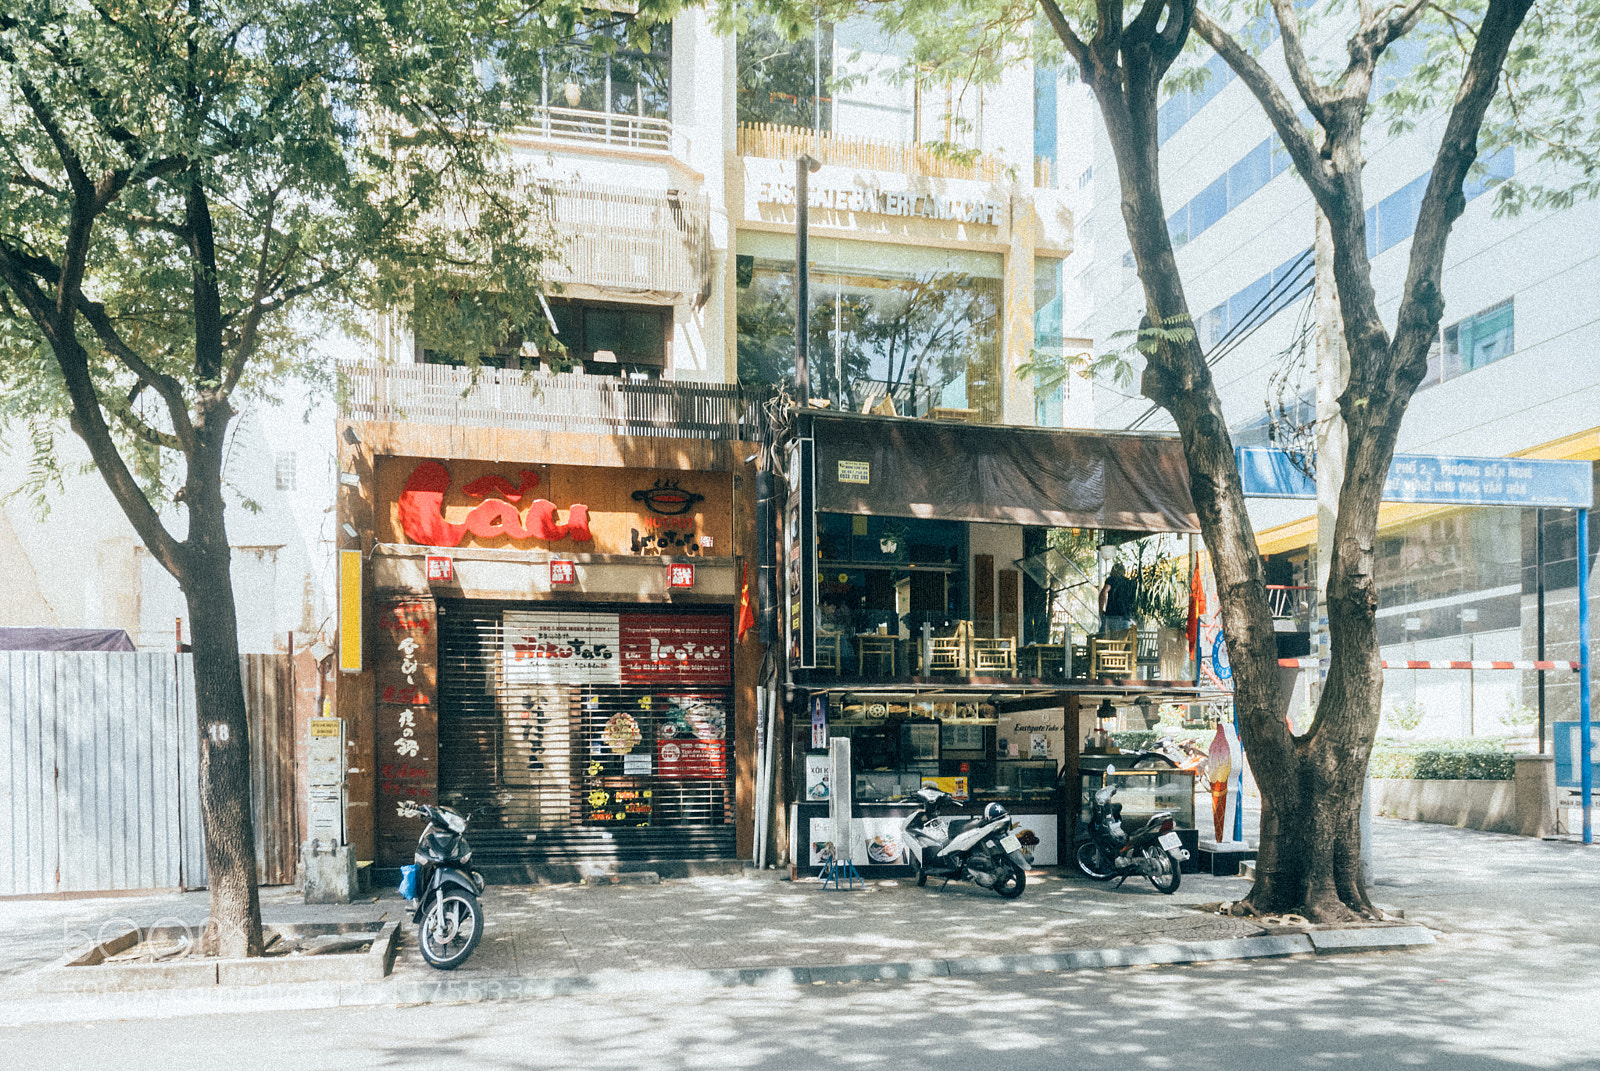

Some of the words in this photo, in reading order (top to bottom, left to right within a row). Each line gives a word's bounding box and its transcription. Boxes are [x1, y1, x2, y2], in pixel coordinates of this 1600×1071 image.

[851, 187, 920, 218] BAKERY
[1420, 463, 1427, 475] 2
[644, 516, 668, 529] HOT
[670, 517, 693, 529] POT
[209, 724, 230, 742] 18
